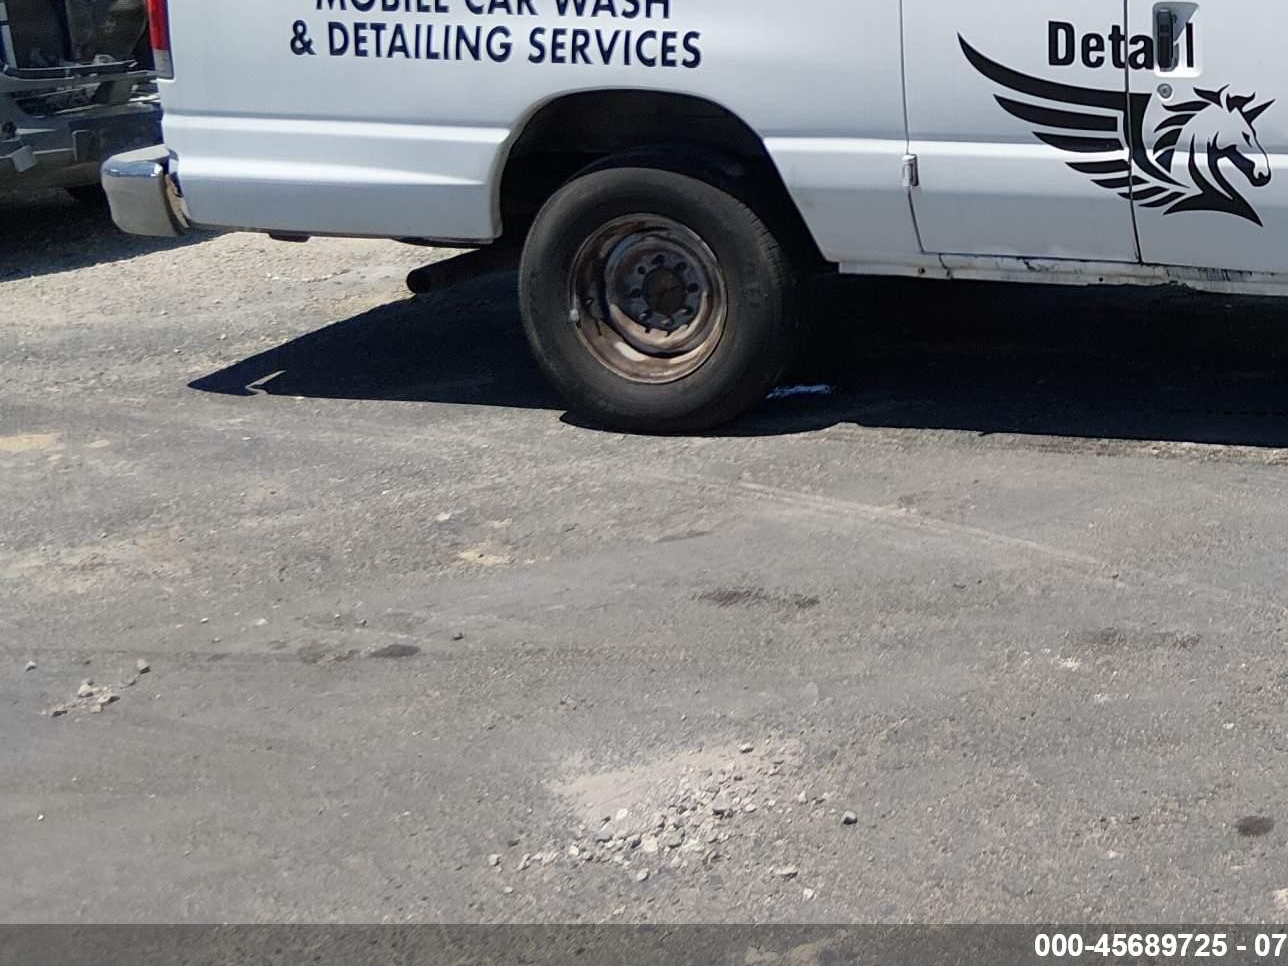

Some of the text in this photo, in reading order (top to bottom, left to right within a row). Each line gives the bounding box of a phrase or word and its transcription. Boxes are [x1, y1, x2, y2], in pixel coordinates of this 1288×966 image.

[289, 19, 703, 69] & DETAILING SERVICES
